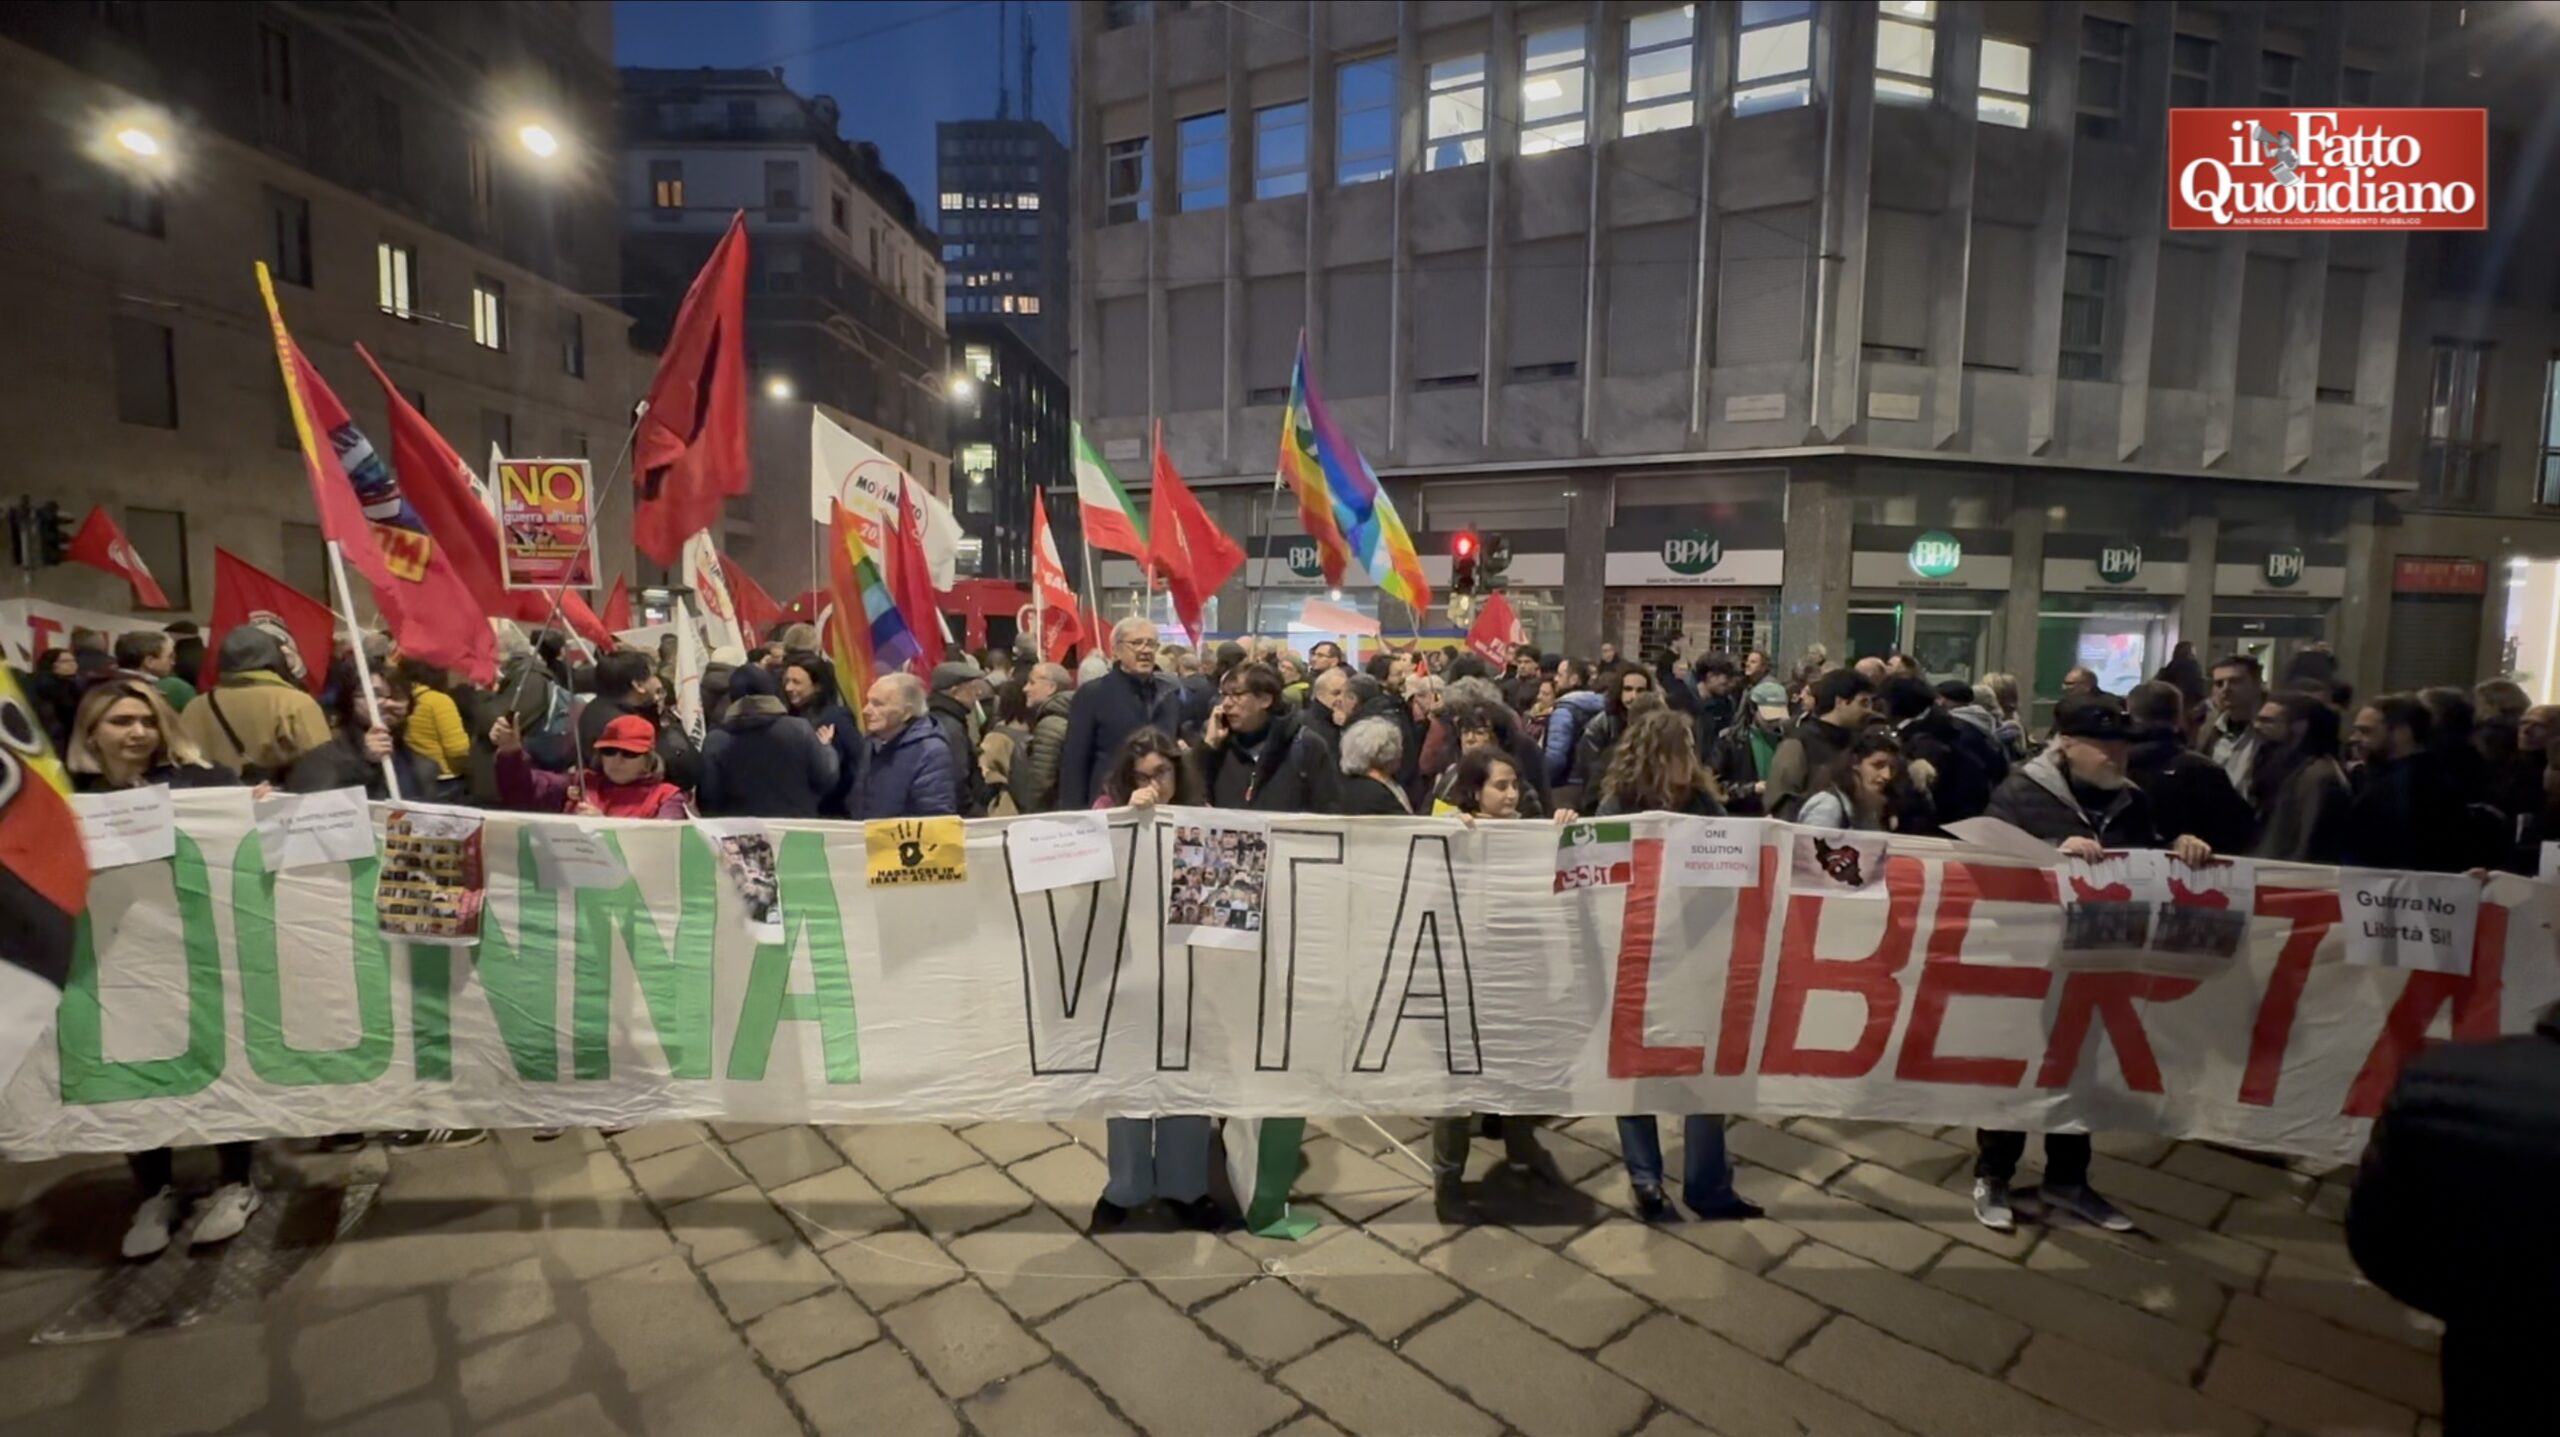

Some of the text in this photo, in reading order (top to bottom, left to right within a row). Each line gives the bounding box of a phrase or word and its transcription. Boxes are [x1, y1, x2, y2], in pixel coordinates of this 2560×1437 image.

[499, 464, 585, 507] NO
[855, 475, 922, 521] MOVIMO
[503, 512, 544, 526] guerra
[1664, 539, 1720, 564] BPM
[1915, 541, 1961, 568] BPM
[2101, 548, 2141, 574] BPM
[1705, 829, 1728, 839] ONE
[1691, 845, 1743, 855] SOLUTION
[877, 867, 939, 878] MASSACRE
[1684, 861, 1749, 871] REVOLUTION
[870, 876, 899, 885] IRAN
[938, 873, 962, 881] NOW
[2427, 896, 2456, 915] No
